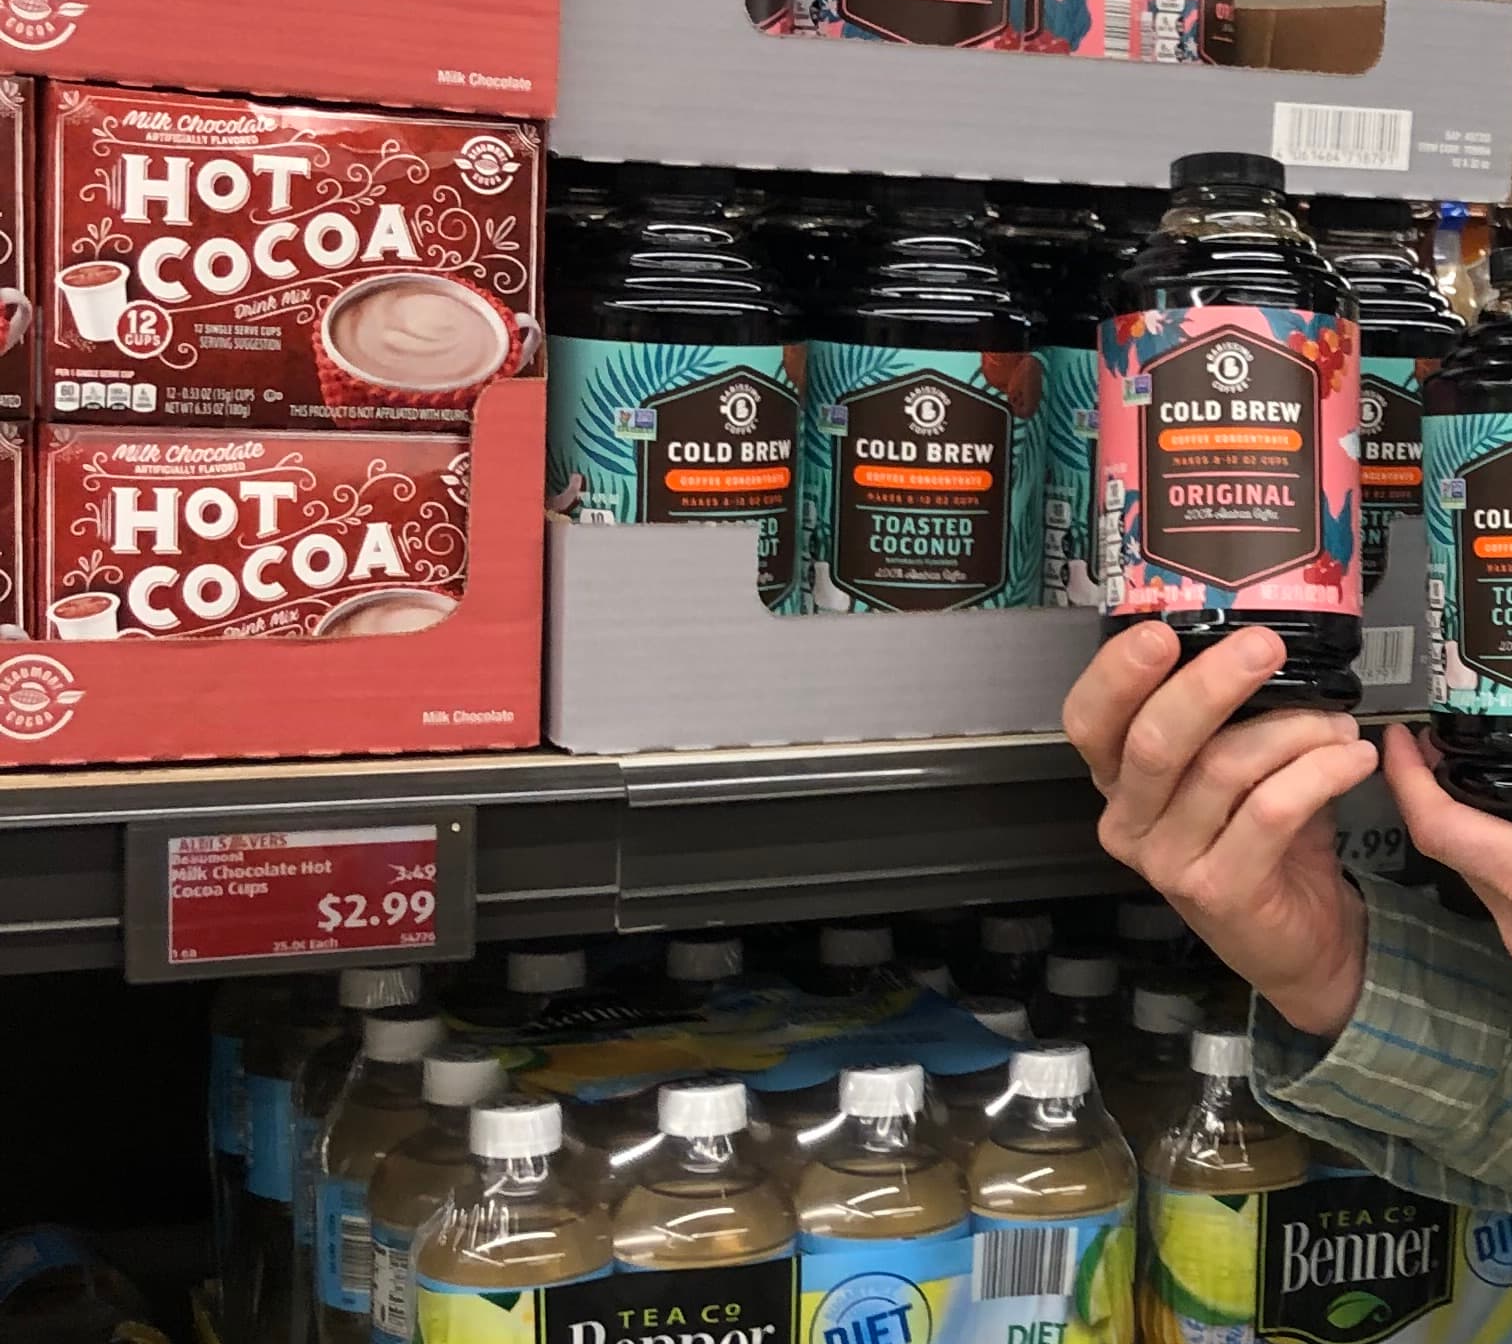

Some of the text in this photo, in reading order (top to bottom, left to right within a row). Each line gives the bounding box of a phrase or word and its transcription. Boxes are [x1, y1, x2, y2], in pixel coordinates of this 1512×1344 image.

[437, 69, 532, 92] Milk Chocolate
[123, 109, 278, 134] Milk Chocolate
[121, 153, 312, 226] HOT
[138, 204, 422, 303] COCOA
[234, 288, 312, 320] Drink Mix
[127, 309, 158, 334] 12
[205, 324, 282, 337] SINGLE SERVE CUPS
[125, 333, 161, 346] CUPS
[290, 405, 307, 417] THIS
[1160, 400, 1301, 423] COLD BREW
[112, 440, 266, 463] Milk Chocolate
[668, 439, 792, 463] COLD BREW
[856, 438, 994, 464] COLD BREW
[1366, 442, 1424, 460] BREW
[1169, 484, 1295, 506] ORIGINAL
[111, 481, 298, 556] HOT
[872, 515, 973, 536] TOASTED
[870, 536, 975, 556] COCONUT
[127, 521, 411, 630] COCOA
[269, 609, 300, 631] Mix
[422, 709, 515, 725] Milk Chocolate
[172, 860, 332, 882] Milk Chocolate Hot
[172, 881, 269, 899] Cocoa Cups
[317, 890, 436, 932] $2.99
[1320, 1211, 1374, 1231] TEA
[1281, 1222, 1441, 1295] Benner
[619, 1308, 686, 1330] TEA
